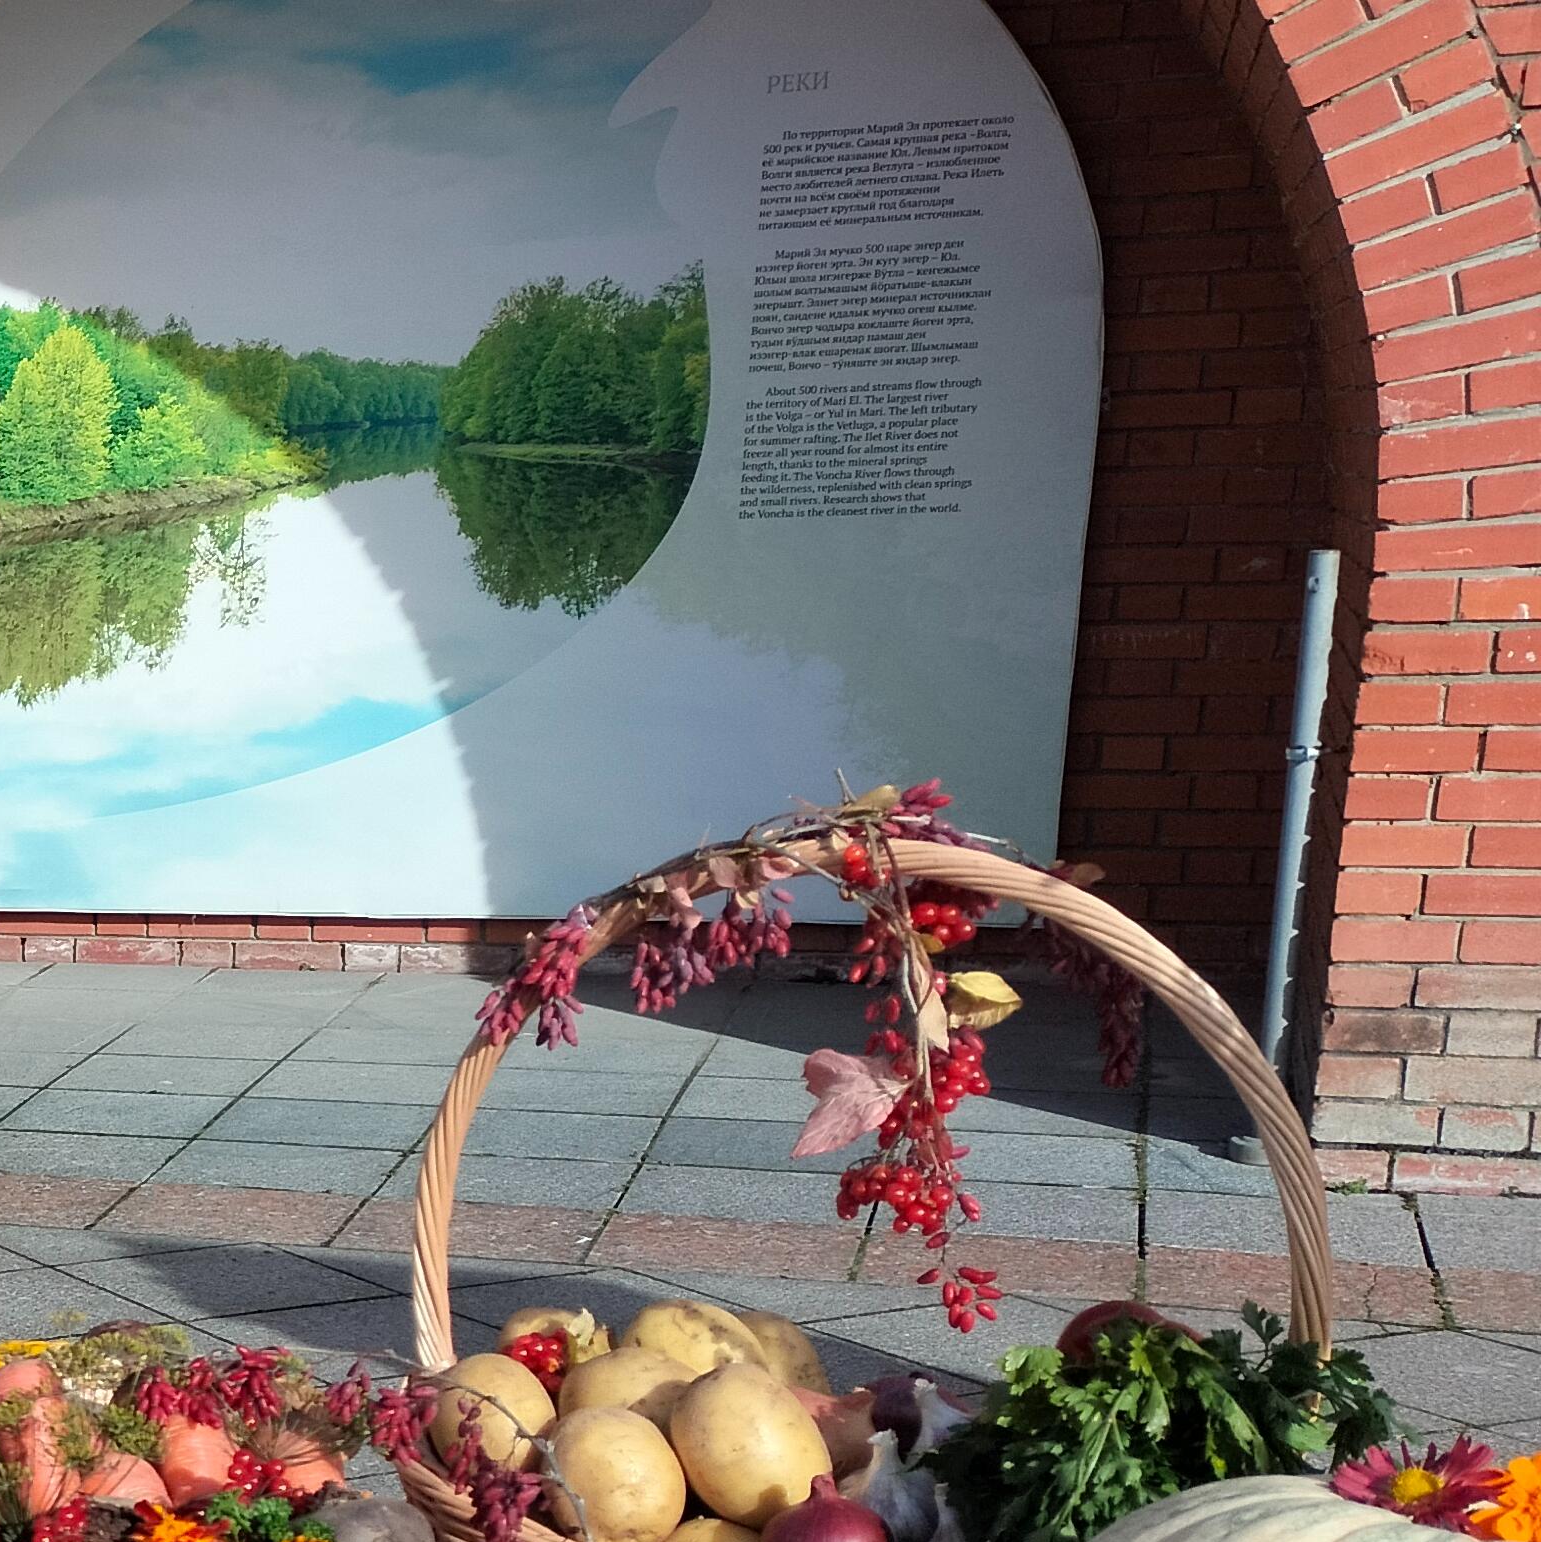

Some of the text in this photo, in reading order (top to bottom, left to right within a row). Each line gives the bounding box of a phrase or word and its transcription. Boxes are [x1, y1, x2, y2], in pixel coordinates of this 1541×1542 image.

[767, 71, 830, 94] РЕКИ
[782, 117, 1014, 141] По территории Марий Эл протекает около
[763, 144, 781, 154] 500
[783, 144, 801, 154] рек
[814, 141, 853, 152] ручьев.
[856, 137, 890, 148] Самая
[893, 135, 938, 147] крупная
[941, 134, 966, 144] река
[971, 129, 1010, 142] –Волга,
[761, 157, 773, 167] её
[776, 153, 834, 167] марийское
[890, 148, 909, 158] Юл.
[913, 145, 950, 156] Левым
[953, 143, 1008, 155] притоком
[761, 169, 792, 180] Волги
[844, 165, 869, 175] река
[872, 160, 913, 173] Ветлуга
[760, 183, 791, 192] место
[794, 177, 852, 190] любителей
[855, 176, 897, 186] летнего
[943, 169, 968, 180] Река
[970, 167, 1004, 178] Илеть
[759, 196, 791, 205] почти
[810, 191, 835, 201] всём
[837, 189, 870, 199] своём
[873, 186, 940, 199] протяжении
[830, 201, 875, 214] круглый
[878, 200, 896, 211] год
[898, 196, 954, 210] благодаря
[758, 209, 983, 231] питающим её минеральным источникам.
[774, 248, 810, 260] Марий
[814, 247, 826, 257] Эл
[865, 244, 884, 254] 500
[765, 378, 981, 396] About 500 rivers and streams flow through
[746, 392, 947, 410] the territory of Mari El. The largest river
[756, 411, 772, 421] the
[775, 410, 802, 422] Volga
[813, 411, 824, 419] or
[829, 409, 843, 418] Yul
[846, 408, 856, 417] in
[859, 407, 884, 417] Mari.
[890, 406, 908, 416] The
[911, 405, 927, 415] left
[931, 404, 976, 416] tributary
[744, 425, 754, 434] of
[757, 424, 773, 433] the
[776, 423, 803, 434] Volga
[817, 421, 833, 431] the
[837, 420, 878, 432] Vetluga,
[888, 418, 927, 430] popular
[930, 416, 958, 428] place
[743, 429, 957, 446] for summer rafting. The Ilet River does not
[742, 442, 947, 458] freeze all year round for almost its entire
[742, 455, 926, 471] length, thanks to the mineral springs
[741, 472, 778, 484] feeding
[794, 471, 812, 480] The
[815, 470, 851, 480] Voncha
[854, 469, 879, 478] River
[883, 468, 910, 477] flows
[913, 466, 954, 478] through
[740, 479, 971, 495] the wilderness, replenished with clean springs
[739, 492, 925, 506] and small rivers. Research shows that
[738, 509, 755, 519] the
[758, 508, 793, 518] Voncha
[807, 507, 823, 517] the
[825, 506, 867, 516] cleanest
[870, 505, 893, 515] river
[896, 505, 907, 514] in
[909, 504, 926, 513] the
[929, 503, 960, 513] world.
